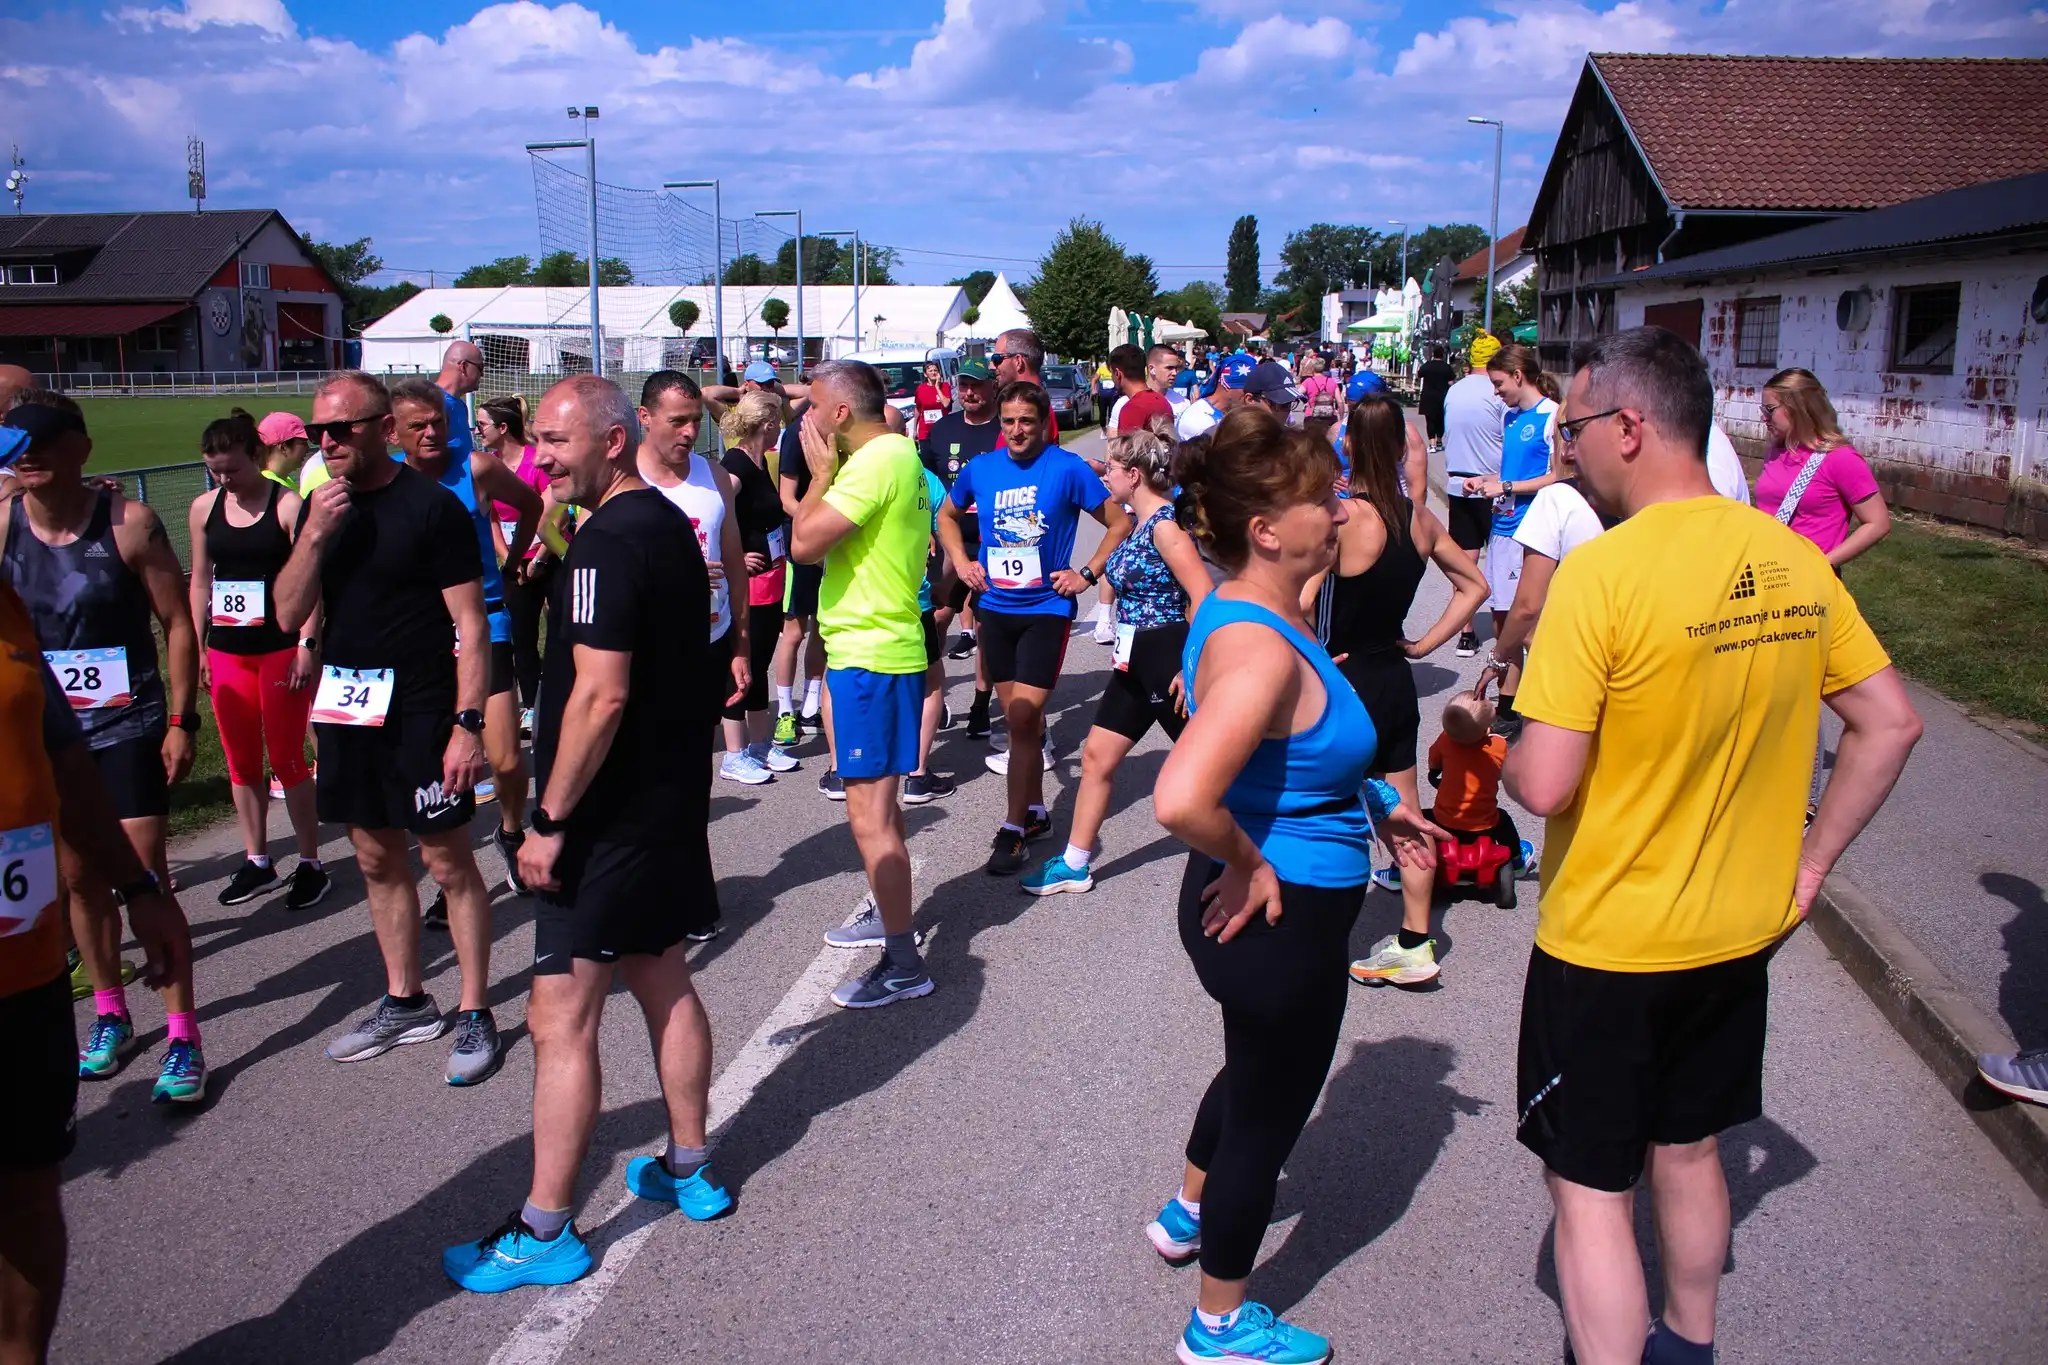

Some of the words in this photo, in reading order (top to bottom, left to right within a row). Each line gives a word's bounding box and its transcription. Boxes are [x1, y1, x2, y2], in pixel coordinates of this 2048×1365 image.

[1001, 559, 1024, 577] 19
[1758, 560, 1778, 569] PUČKO
[1763, 582, 1791, 590] ČAKOVEC
[224, 594, 246, 613] 88
[1685, 622, 1717, 639] Trčim
[1719, 618, 1731, 634] po
[1733, 608, 1768, 626] znanje
[1771, 608, 1781, 620] u
[63, 666, 102, 692] 28
[337, 685, 371, 708] 34
[0, 859, 29, 902] 6
